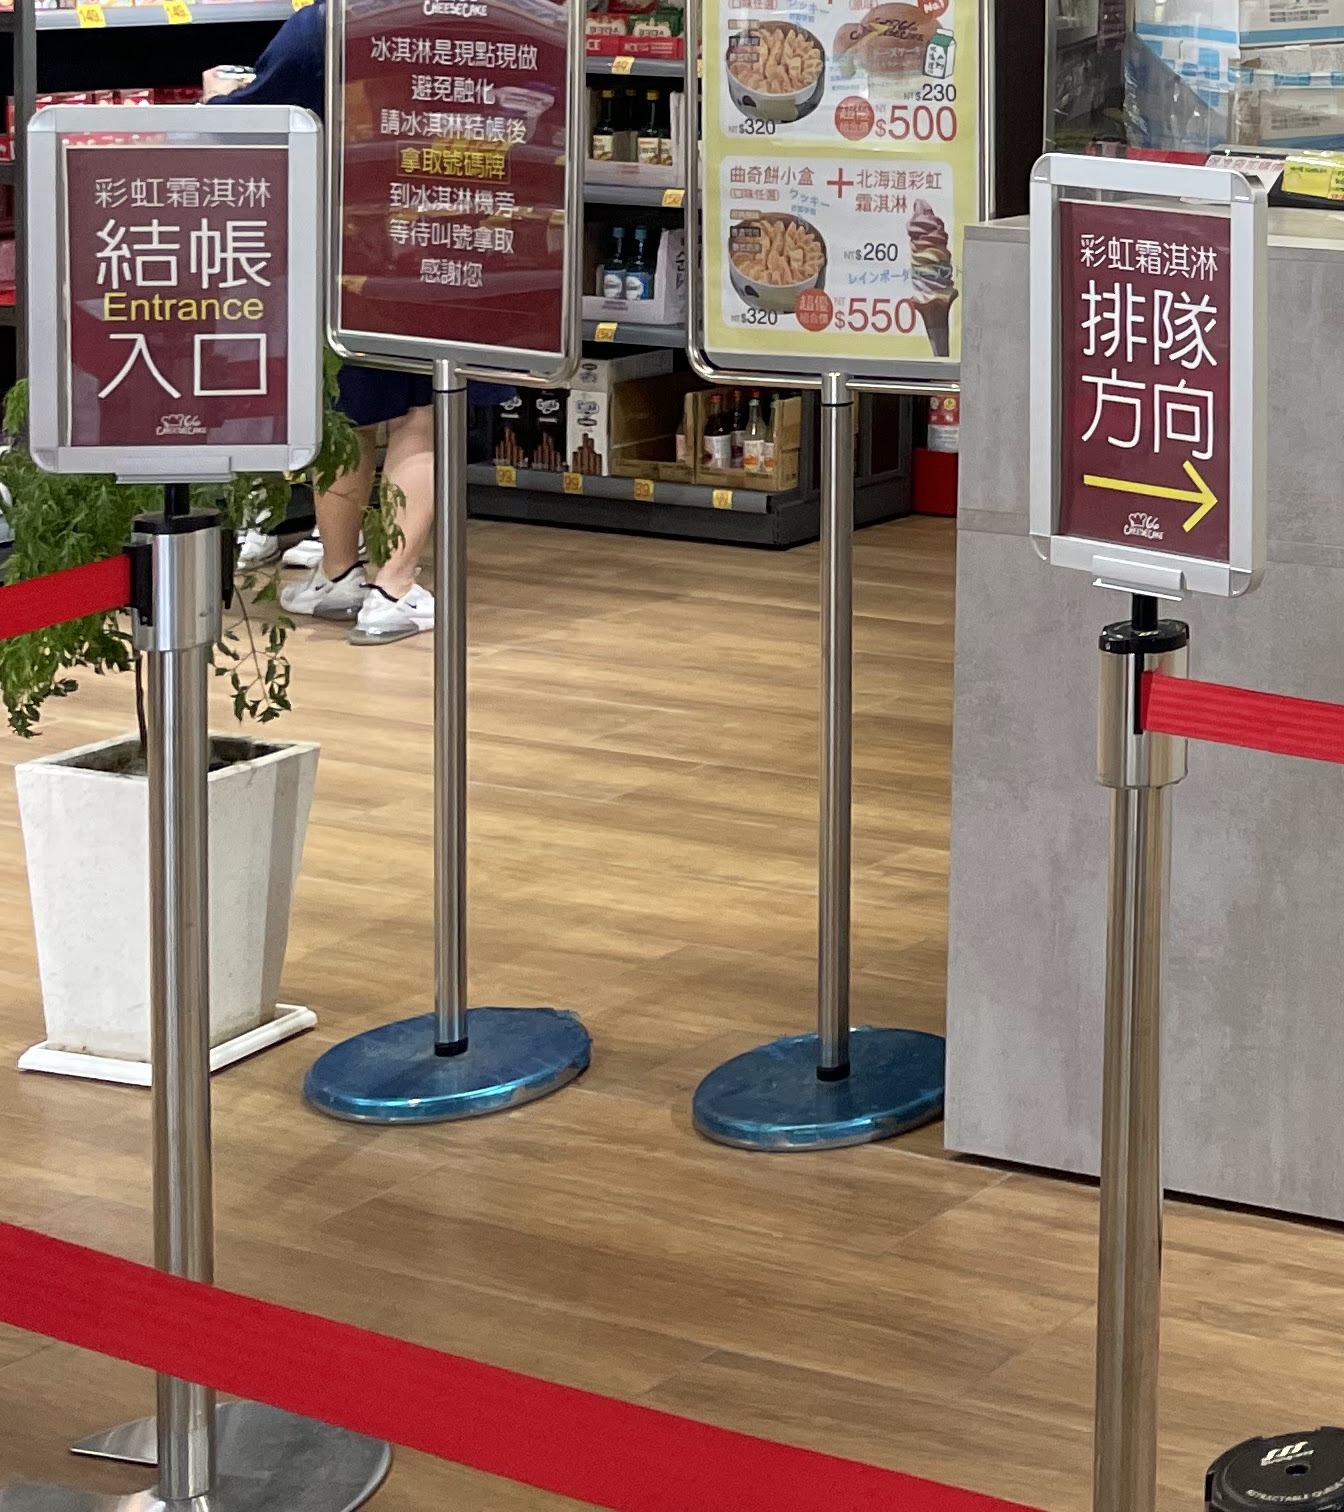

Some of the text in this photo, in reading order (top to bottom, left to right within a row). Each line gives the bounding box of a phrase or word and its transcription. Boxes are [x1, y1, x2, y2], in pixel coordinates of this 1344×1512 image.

[371, 36, 538, 70] 冰淇淋是現點現做
[586, 39, 600, 51] CE
[412, 74, 495, 105] 避免融化
[381, 109, 526, 144] 請冰淇淋結帳後
[875, 105, 957, 141] $500
[400, 147, 505, 179] 拿取號碼牌
[730, 166, 815, 185] 曲奇餅小盒
[857, 169, 942, 190] 北海道彩虹
[95, 177, 271, 209] 彩虹霜淇淋
[390, 183, 515, 218] 到冰淇淋機旁
[856, 194, 907, 213] 霜淇淋
[389, 219, 514, 254] 等待叫號拿取
[96, 218, 271, 290] 結帳
[1080, 232, 1219, 283] 彩虹霜淇淋
[420, 259, 482, 287] 感謝您
[103, 293, 264, 322] Entrance
[834, 297, 916, 333] $550
[1081, 279, 1218, 368] 排隊
[97, 332, 267, 399] 入口
[1081, 368, 1215, 461] 方向
